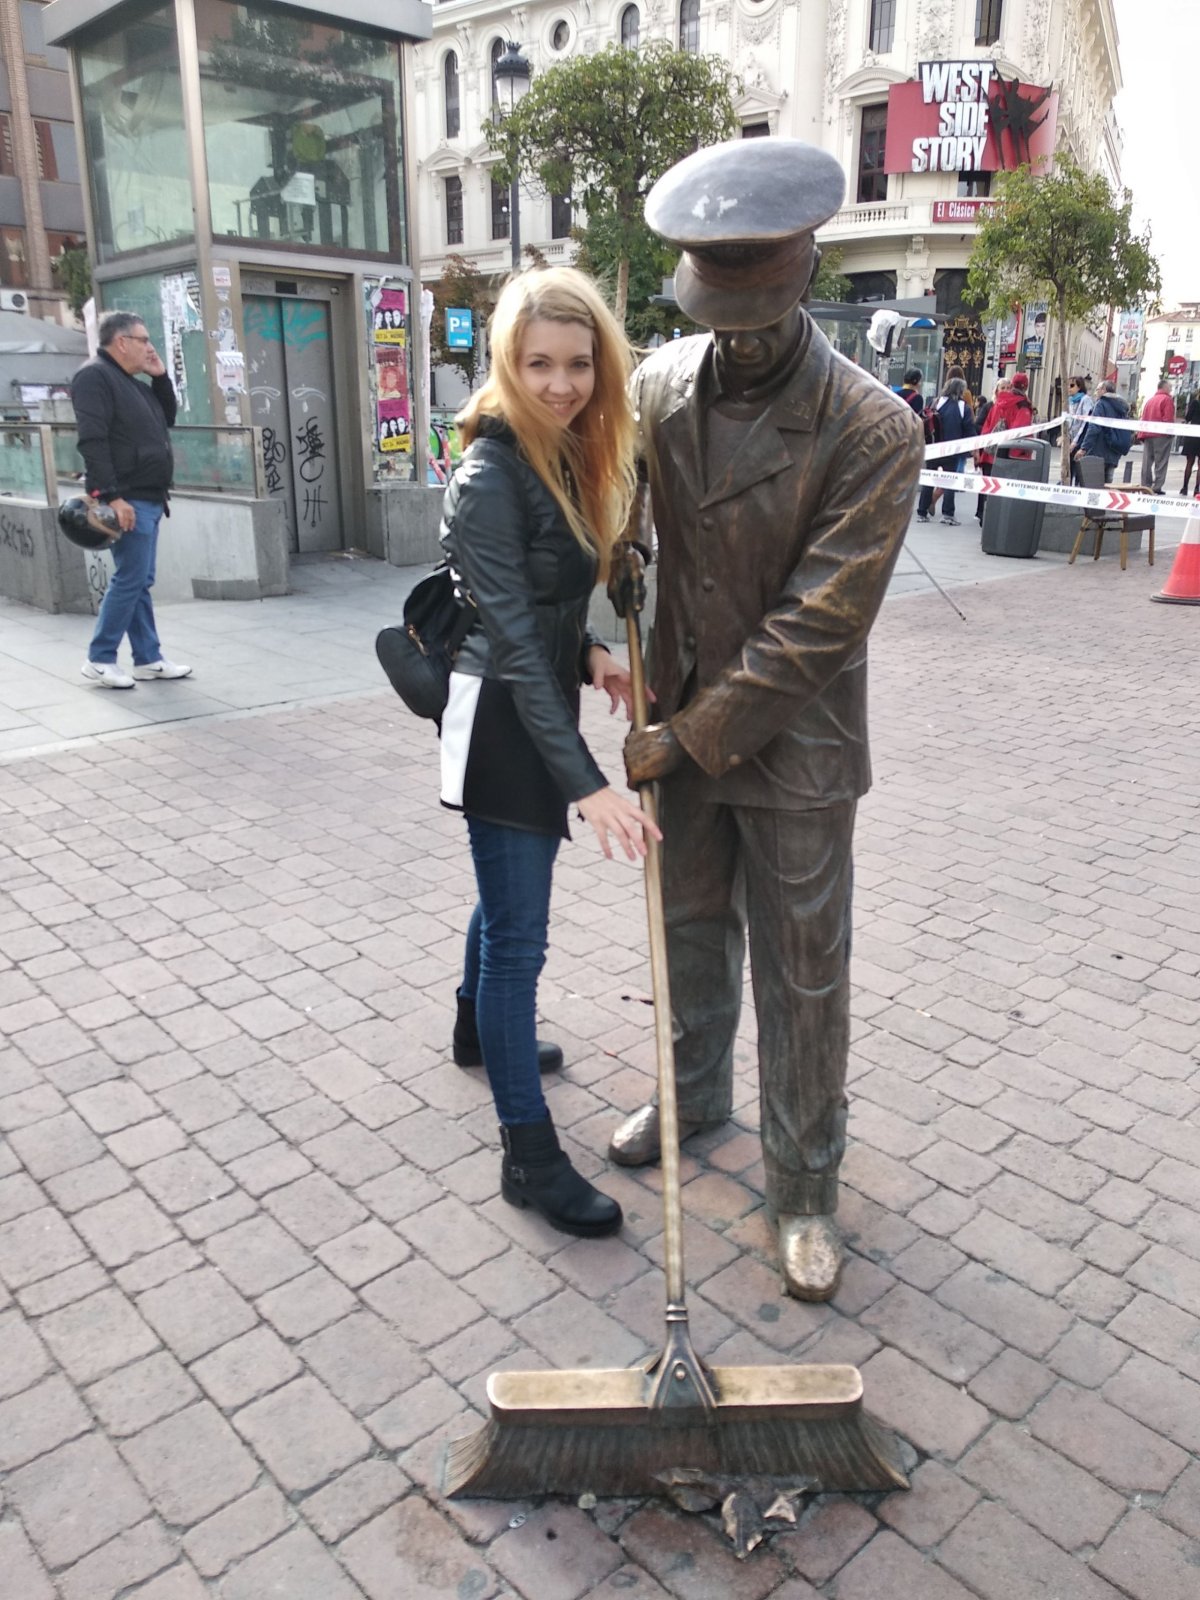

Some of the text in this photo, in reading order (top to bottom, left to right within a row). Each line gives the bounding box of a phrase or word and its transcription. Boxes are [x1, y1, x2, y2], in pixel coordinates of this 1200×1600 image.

[922, 63, 993, 103] WEST
[939, 102, 989, 137] SIDE
[912, 137, 987, 172] STORY
[937, 203, 944, 217] El
[949, 202, 975, 217] Clásico
[450, 317, 460, 332] P
[1011, 482, 1038, 490] EVITEMOS
[1142, 498, 1174, 506] EVITEMOS
